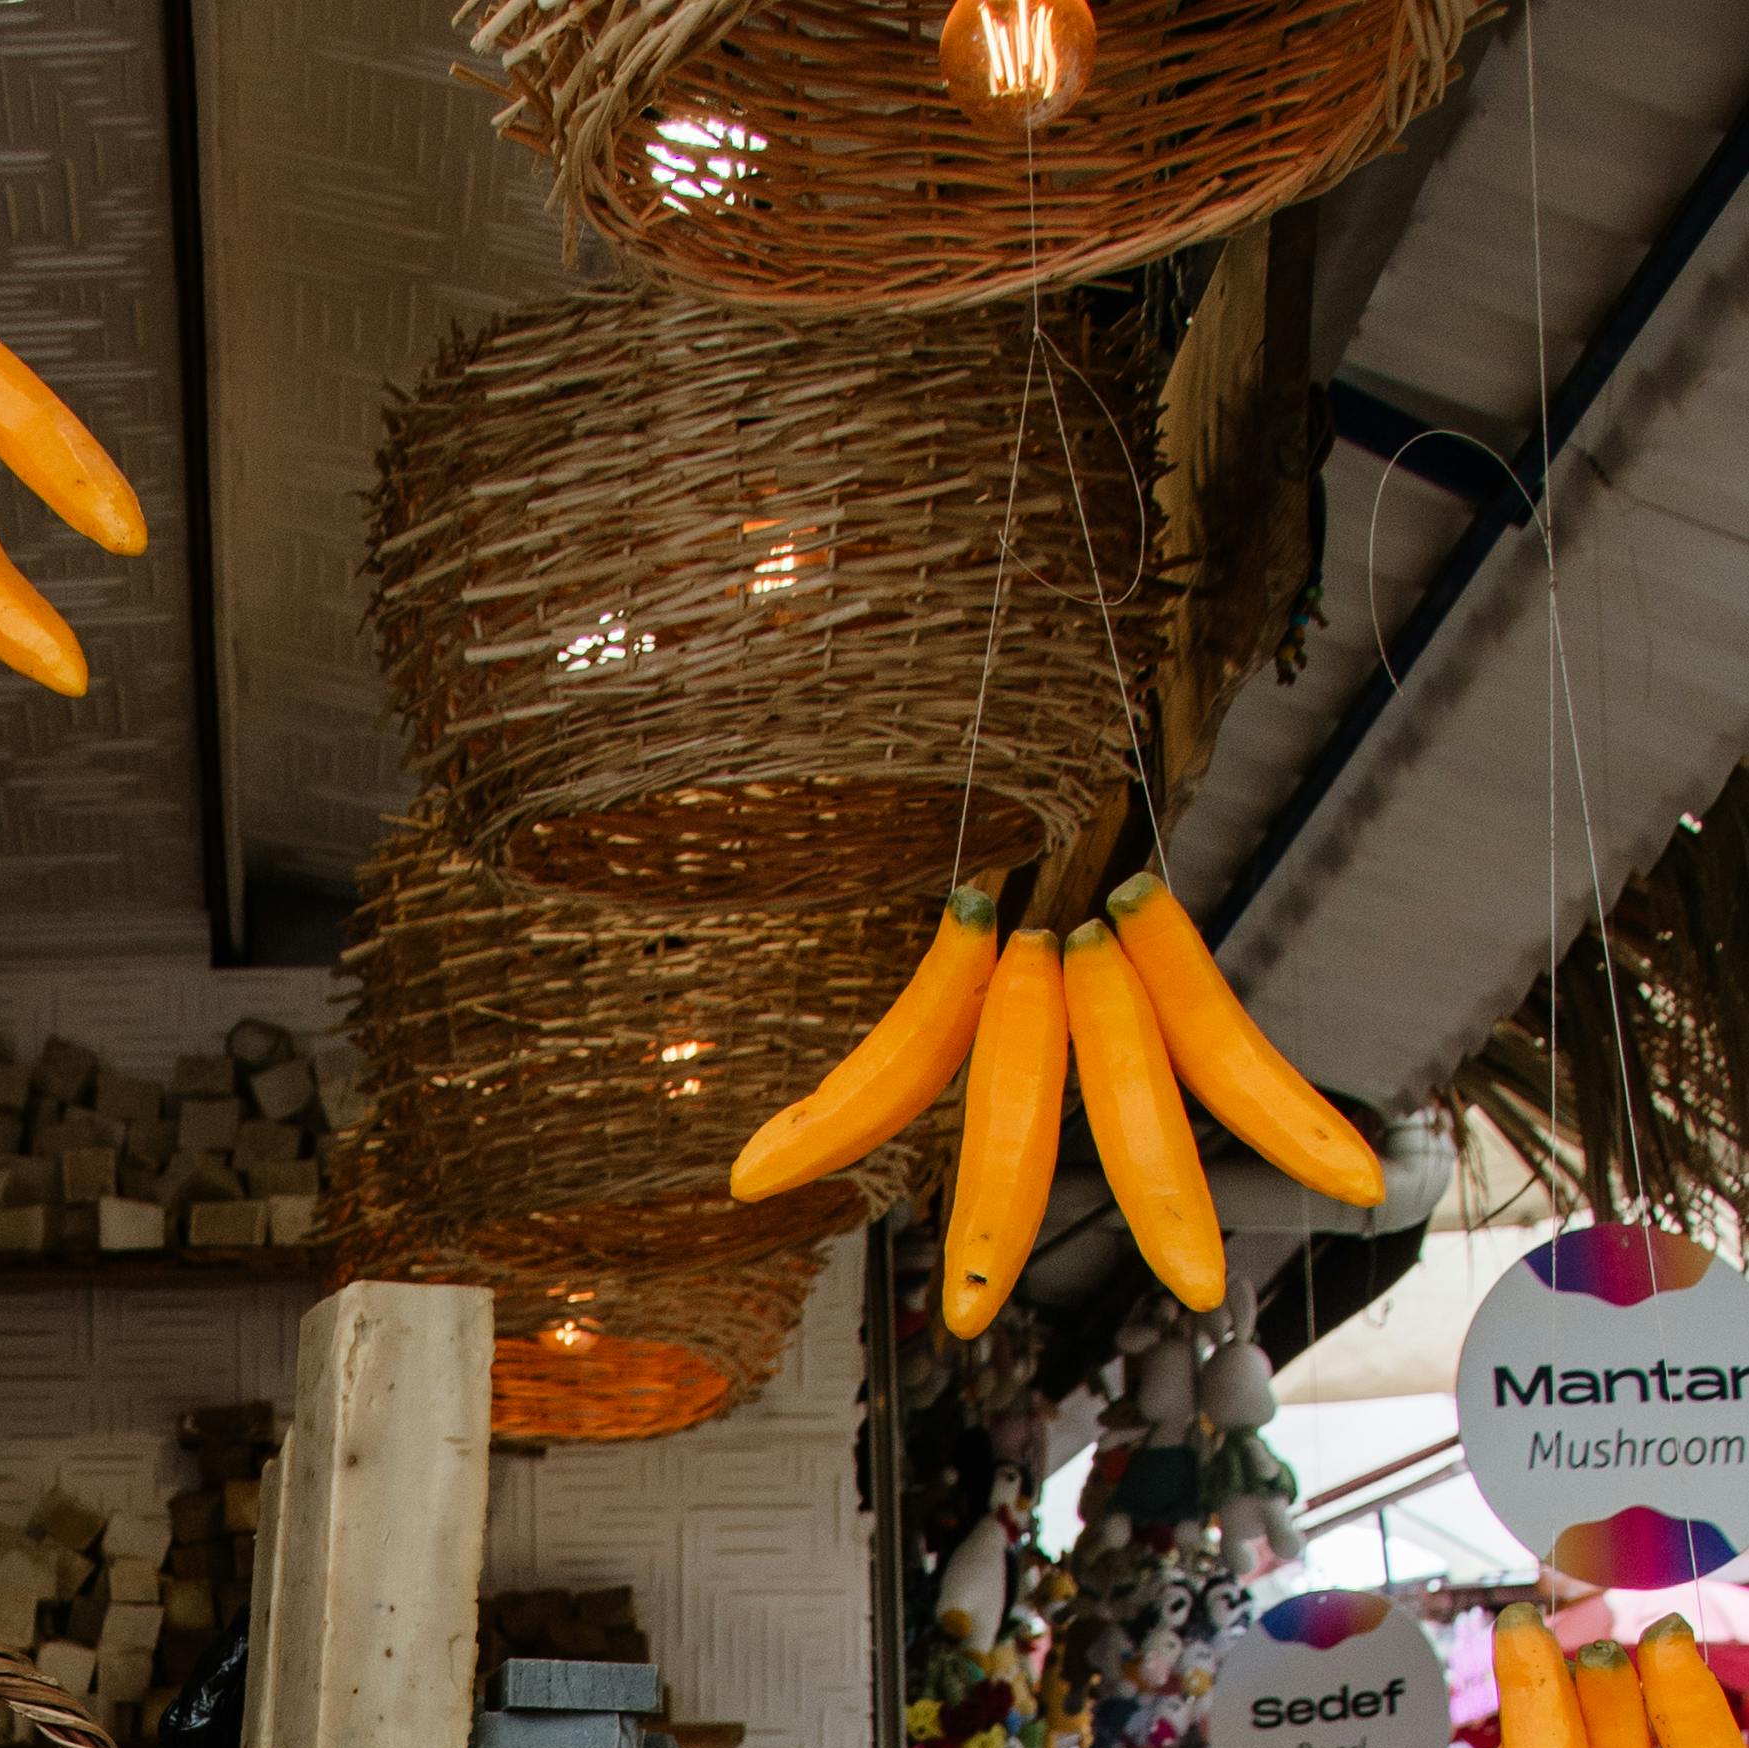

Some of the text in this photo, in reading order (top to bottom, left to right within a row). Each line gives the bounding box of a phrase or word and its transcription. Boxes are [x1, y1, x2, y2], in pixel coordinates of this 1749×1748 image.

[1494, 1358, 1749, 1406] Mantar
[1528, 1428, 1746, 1470] Mushroom
[1251, 1677, 1406, 1729] Sedef
